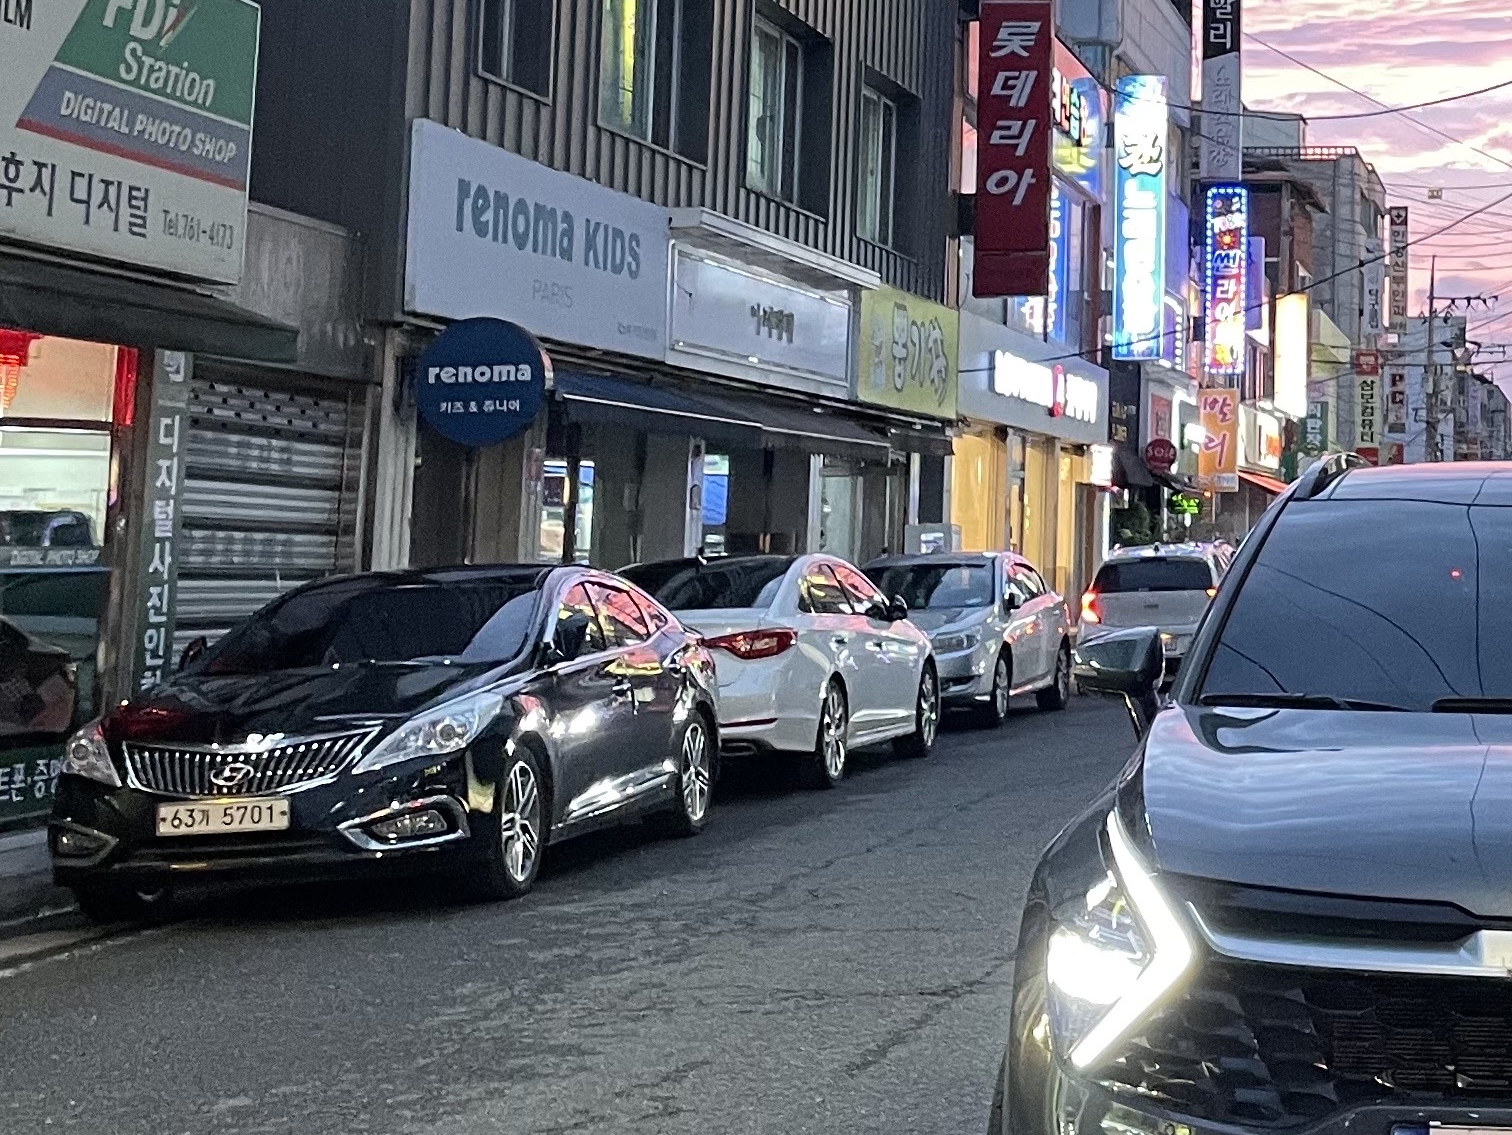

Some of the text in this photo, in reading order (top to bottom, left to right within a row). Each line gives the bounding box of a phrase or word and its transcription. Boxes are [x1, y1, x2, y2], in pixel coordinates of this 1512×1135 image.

[120, 42, 216, 108] Station
[60, 90, 238, 164] DIGITAL PHOTO SHOP
[985, 21, 1041, 206] 롯데리아
[69, 169, 151, 238] 디지털
[456, 176, 641, 280] renoma KIDS
[428, 364, 532, 384] renoma
[440, 401, 464, 414] 키즈
[468, 401, 479, 413] &
[221, 803, 273, 826] 5701
